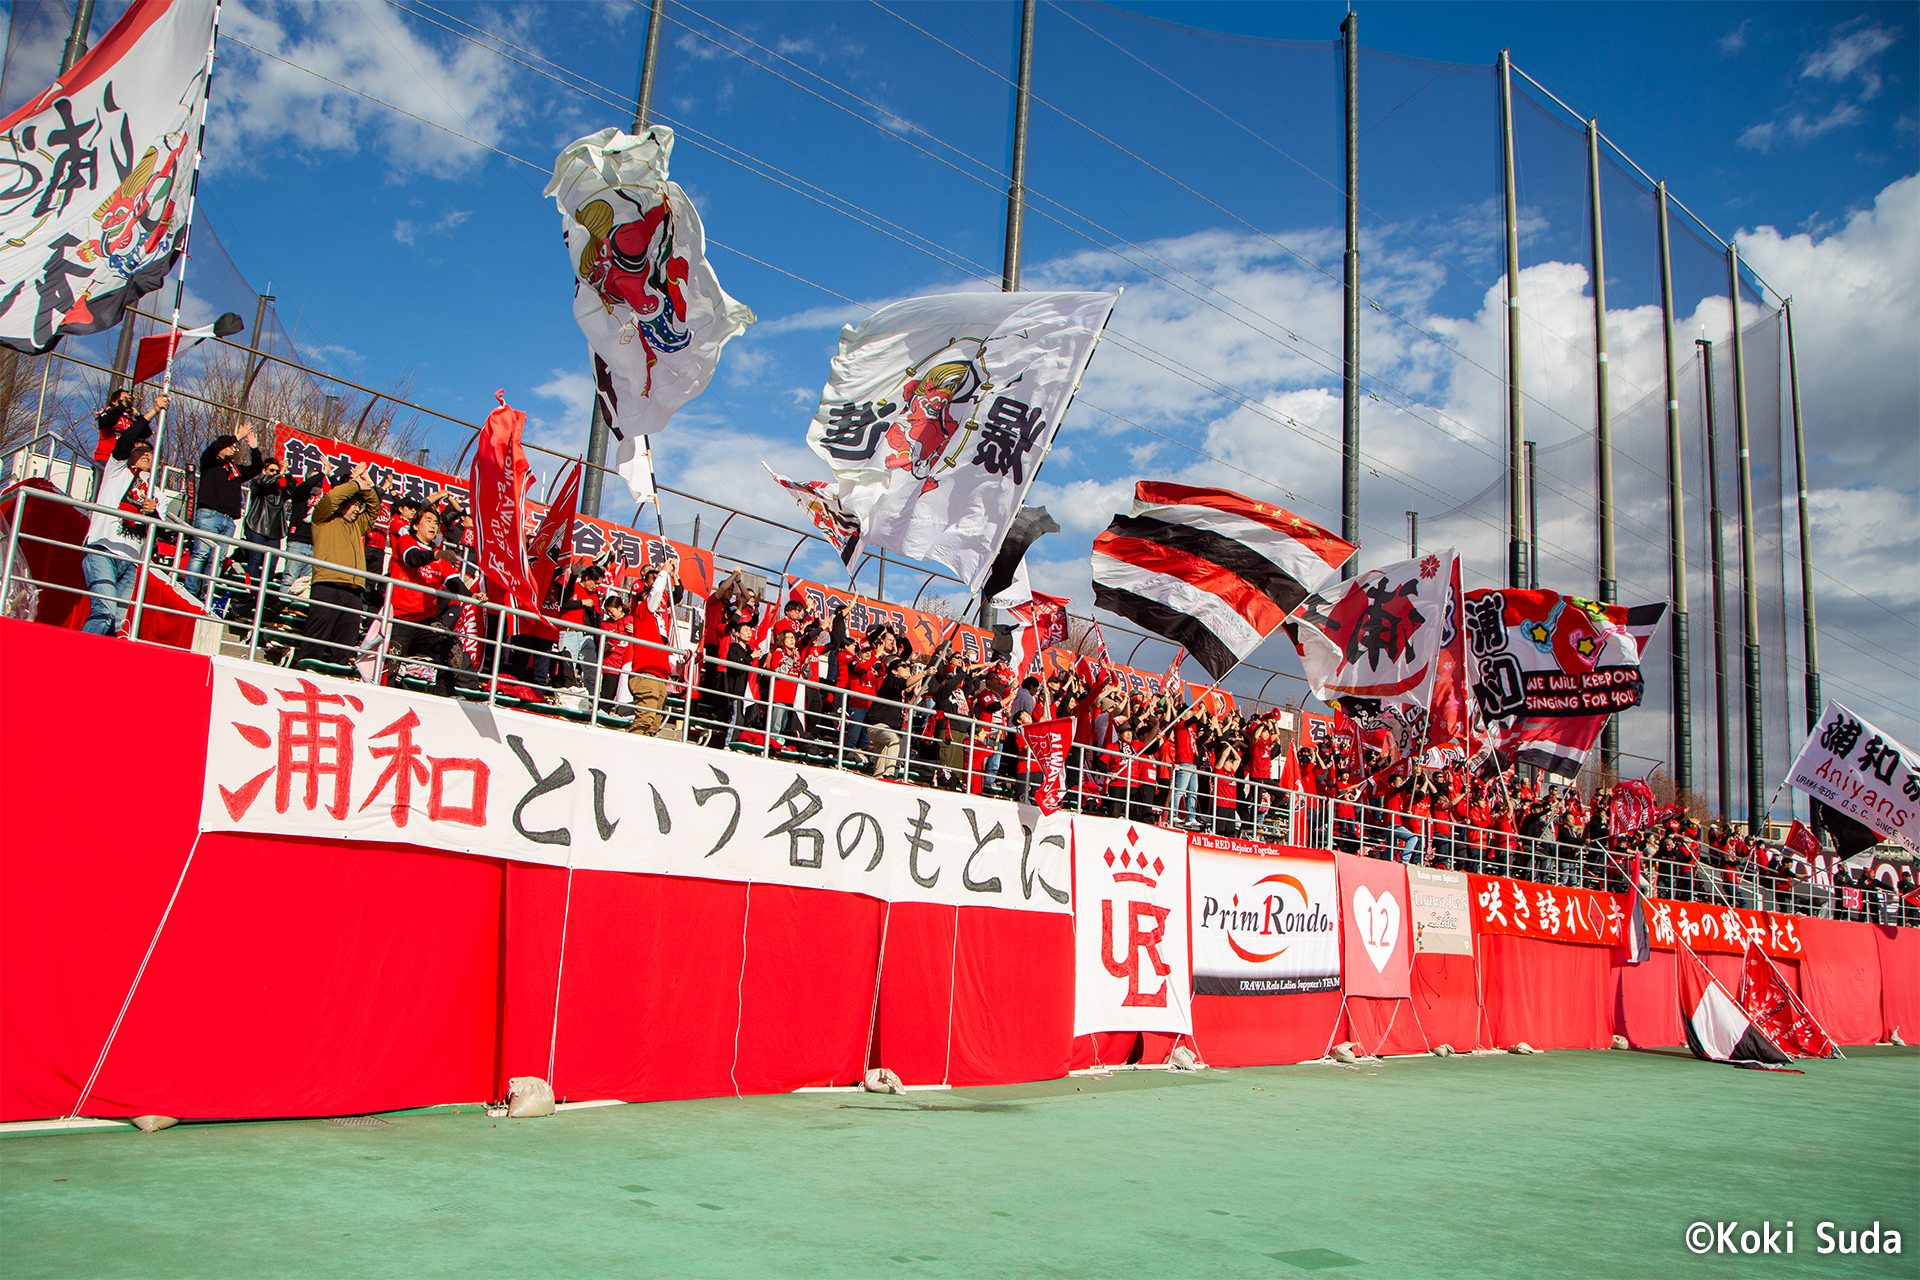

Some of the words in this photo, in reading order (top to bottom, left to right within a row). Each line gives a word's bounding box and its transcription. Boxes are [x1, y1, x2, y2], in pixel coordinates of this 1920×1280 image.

[1464, 592, 1525, 715] 浦和
[1526, 677, 1544, 691] WE
[1582, 672, 1612, 689] KEEP
[1613, 670, 1638, 684] ON
[1582, 693, 1608, 708] FOR
[217, 677, 1070, 905] 浦和という名のもとに
[1875, 818, 1898, 838] SINCE
[1191, 835, 1202, 846] All
[1202, 837, 1214, 848] The
[1214, 839, 1231, 850] RED
[1231, 841, 1252, 855] Rejoice
[1412, 890, 1446, 909] Urawa
[1367, 906, 1390, 948] 12
[1322, 977, 1340, 988] TEAM
